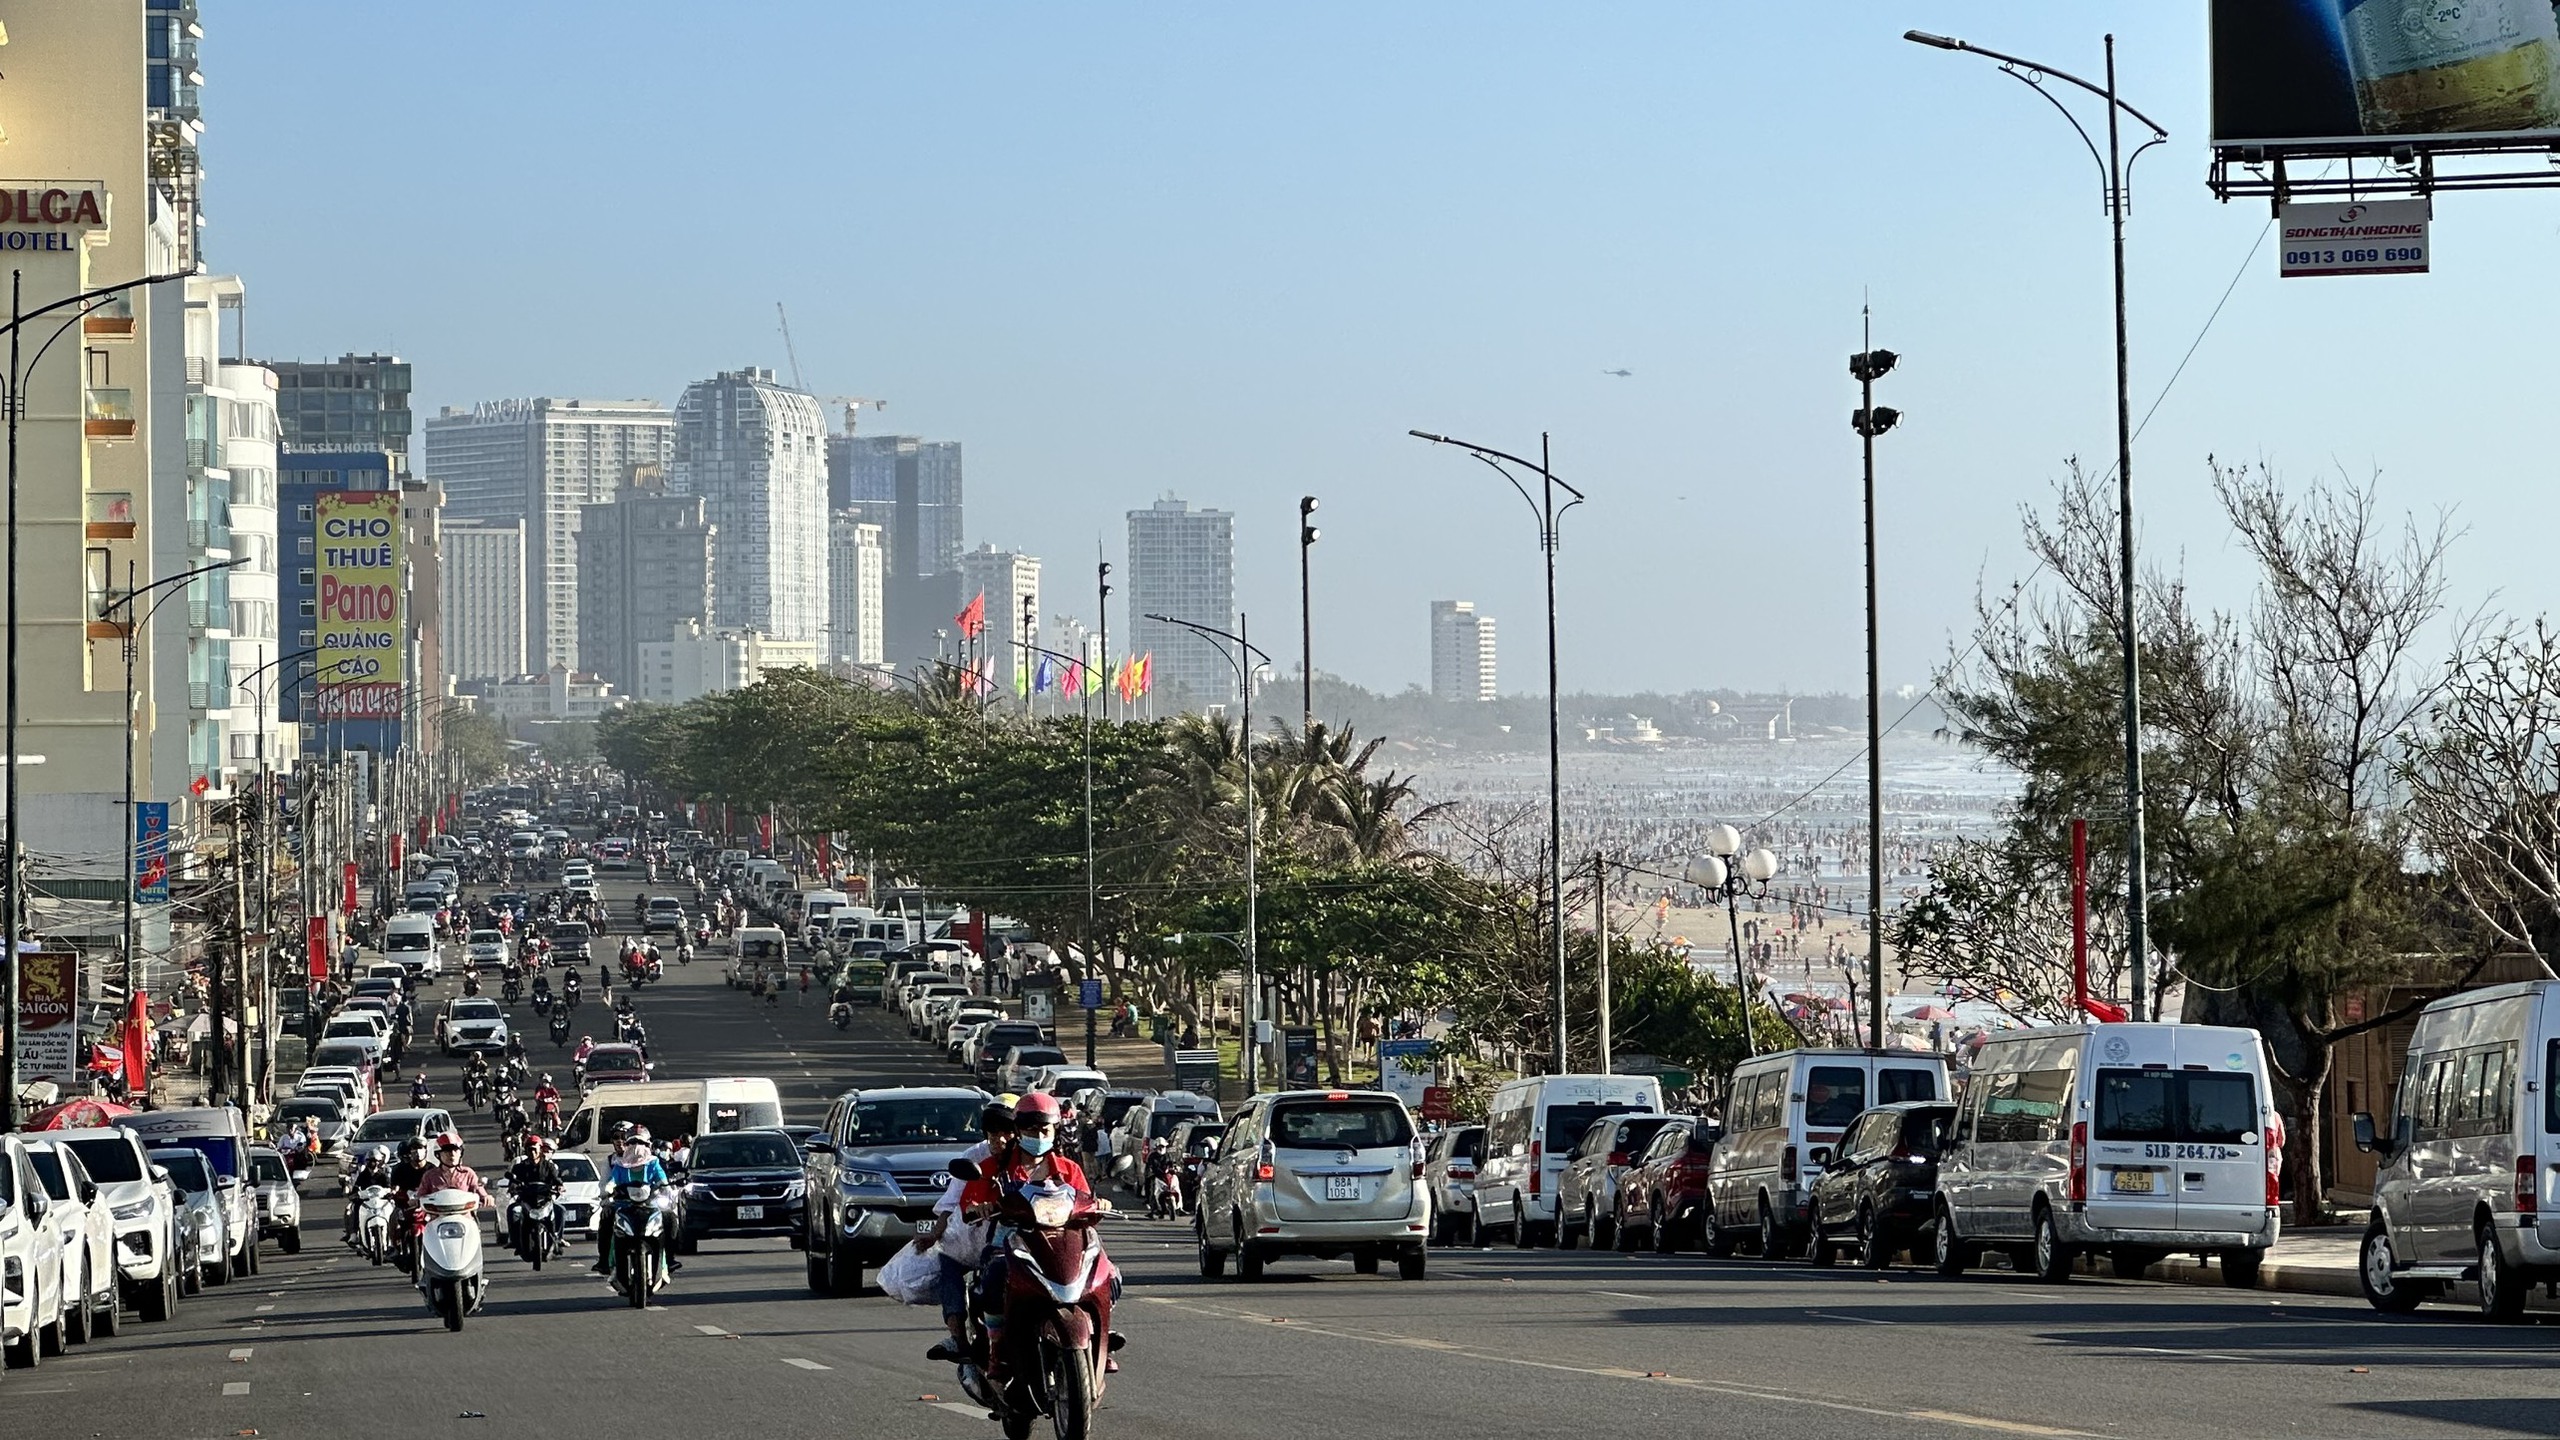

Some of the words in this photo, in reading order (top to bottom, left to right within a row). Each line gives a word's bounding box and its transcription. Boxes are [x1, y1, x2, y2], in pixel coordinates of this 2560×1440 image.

[0, 231, 74, 251] OTEL
[2286, 250, 2335, 264] 0913
[2342, 249, 2378, 262] 069
[2385, 247, 2422, 261] 690
[282, 442, 316, 454] BLUE
[317, 442, 342, 454] SEA
[344, 442, 385, 454] HOTEL
[325, 518, 391, 538] CHO
[324, 543, 393, 567] THUÊ
[321, 574, 396, 622] Pano
[324, 628, 393, 649] QUẢNG
[337, 654, 380, 674] CÁO
[349, 687, 363, 713] 03
[18, 1002, 69, 1014] SAIGON
[2145, 1144, 2170, 1158] 51B
[2177, 1145, 2226, 1160] 264.73
[1334, 1177, 1352, 1187] 68A
[2126, 1172, 2144, 1181] 51B
